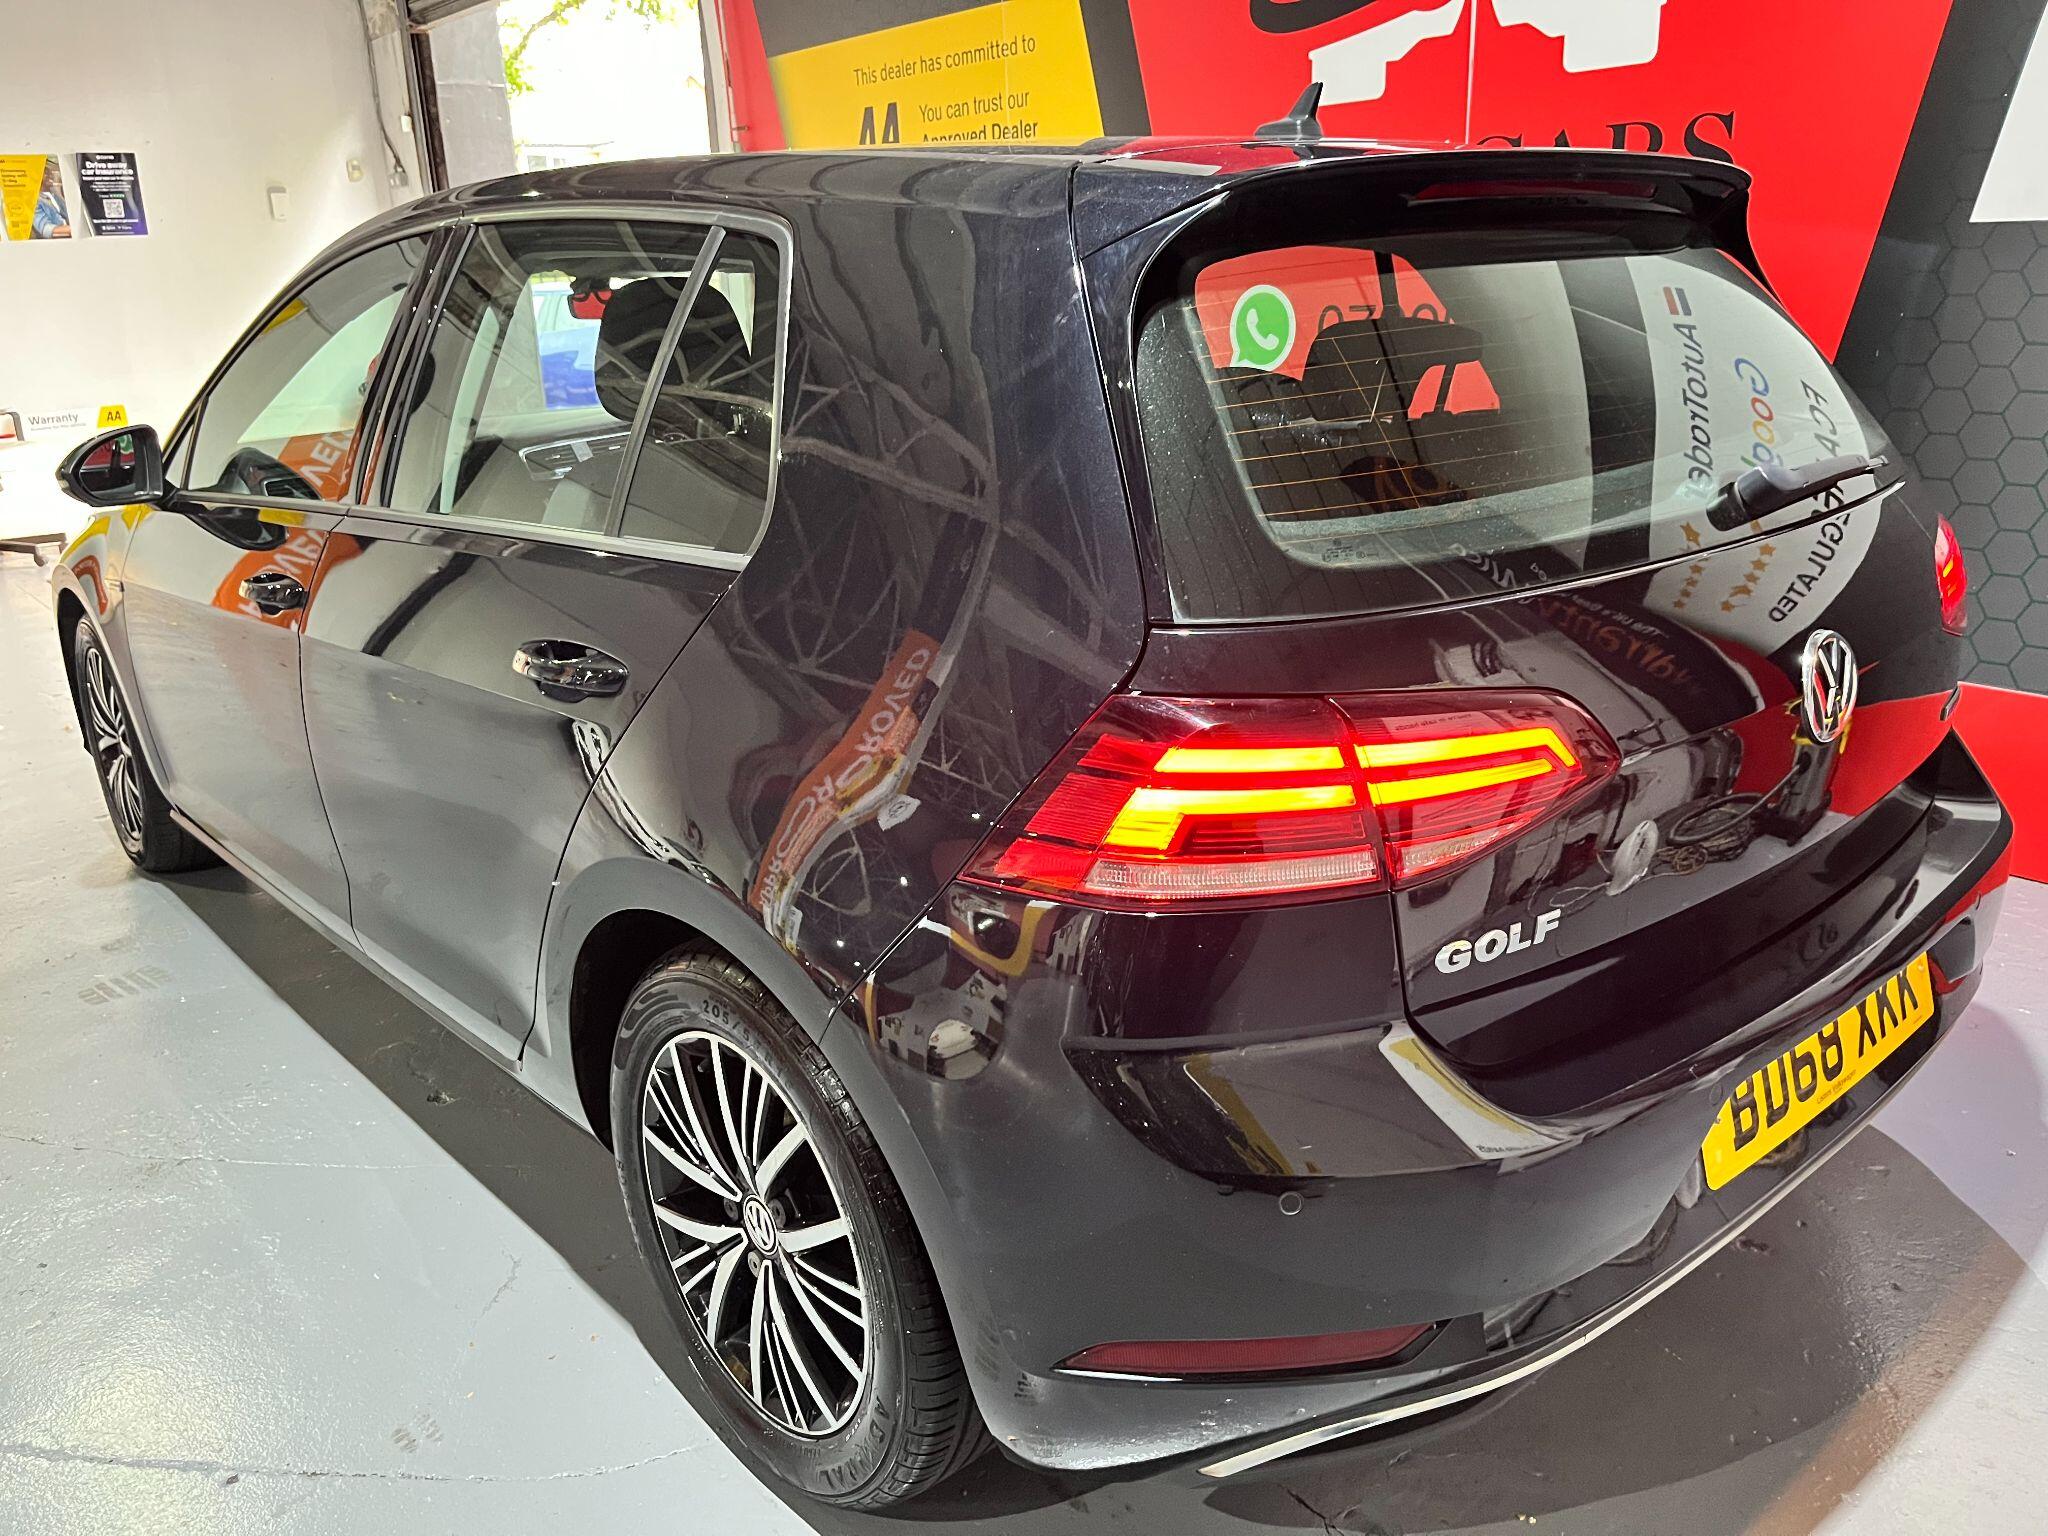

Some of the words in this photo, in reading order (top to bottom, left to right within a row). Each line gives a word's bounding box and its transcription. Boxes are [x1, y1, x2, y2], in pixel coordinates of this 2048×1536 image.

[853, 66, 878, 87] This
[880, 57, 917, 82] dealer
[920, 54, 942, 75] has
[945, 35, 1018, 69] committed
[1021, 34, 1036, 53] to
[919, 103, 942, 123] You
[946, 101, 970, 119] can
[973, 92, 1003, 115] trust
[1008, 91, 1030, 109] our
[991, 119, 1038, 140] Dealer
[85, 161, 107, 170] Drive
[95, 168, 134, 176] insurance
[28, 412, 79, 426] Warranty
[106, 410, 122, 422] AA
[1434, 908, 1562, 974] GOLF
[1854, 966, 1919, 1059] XKK
